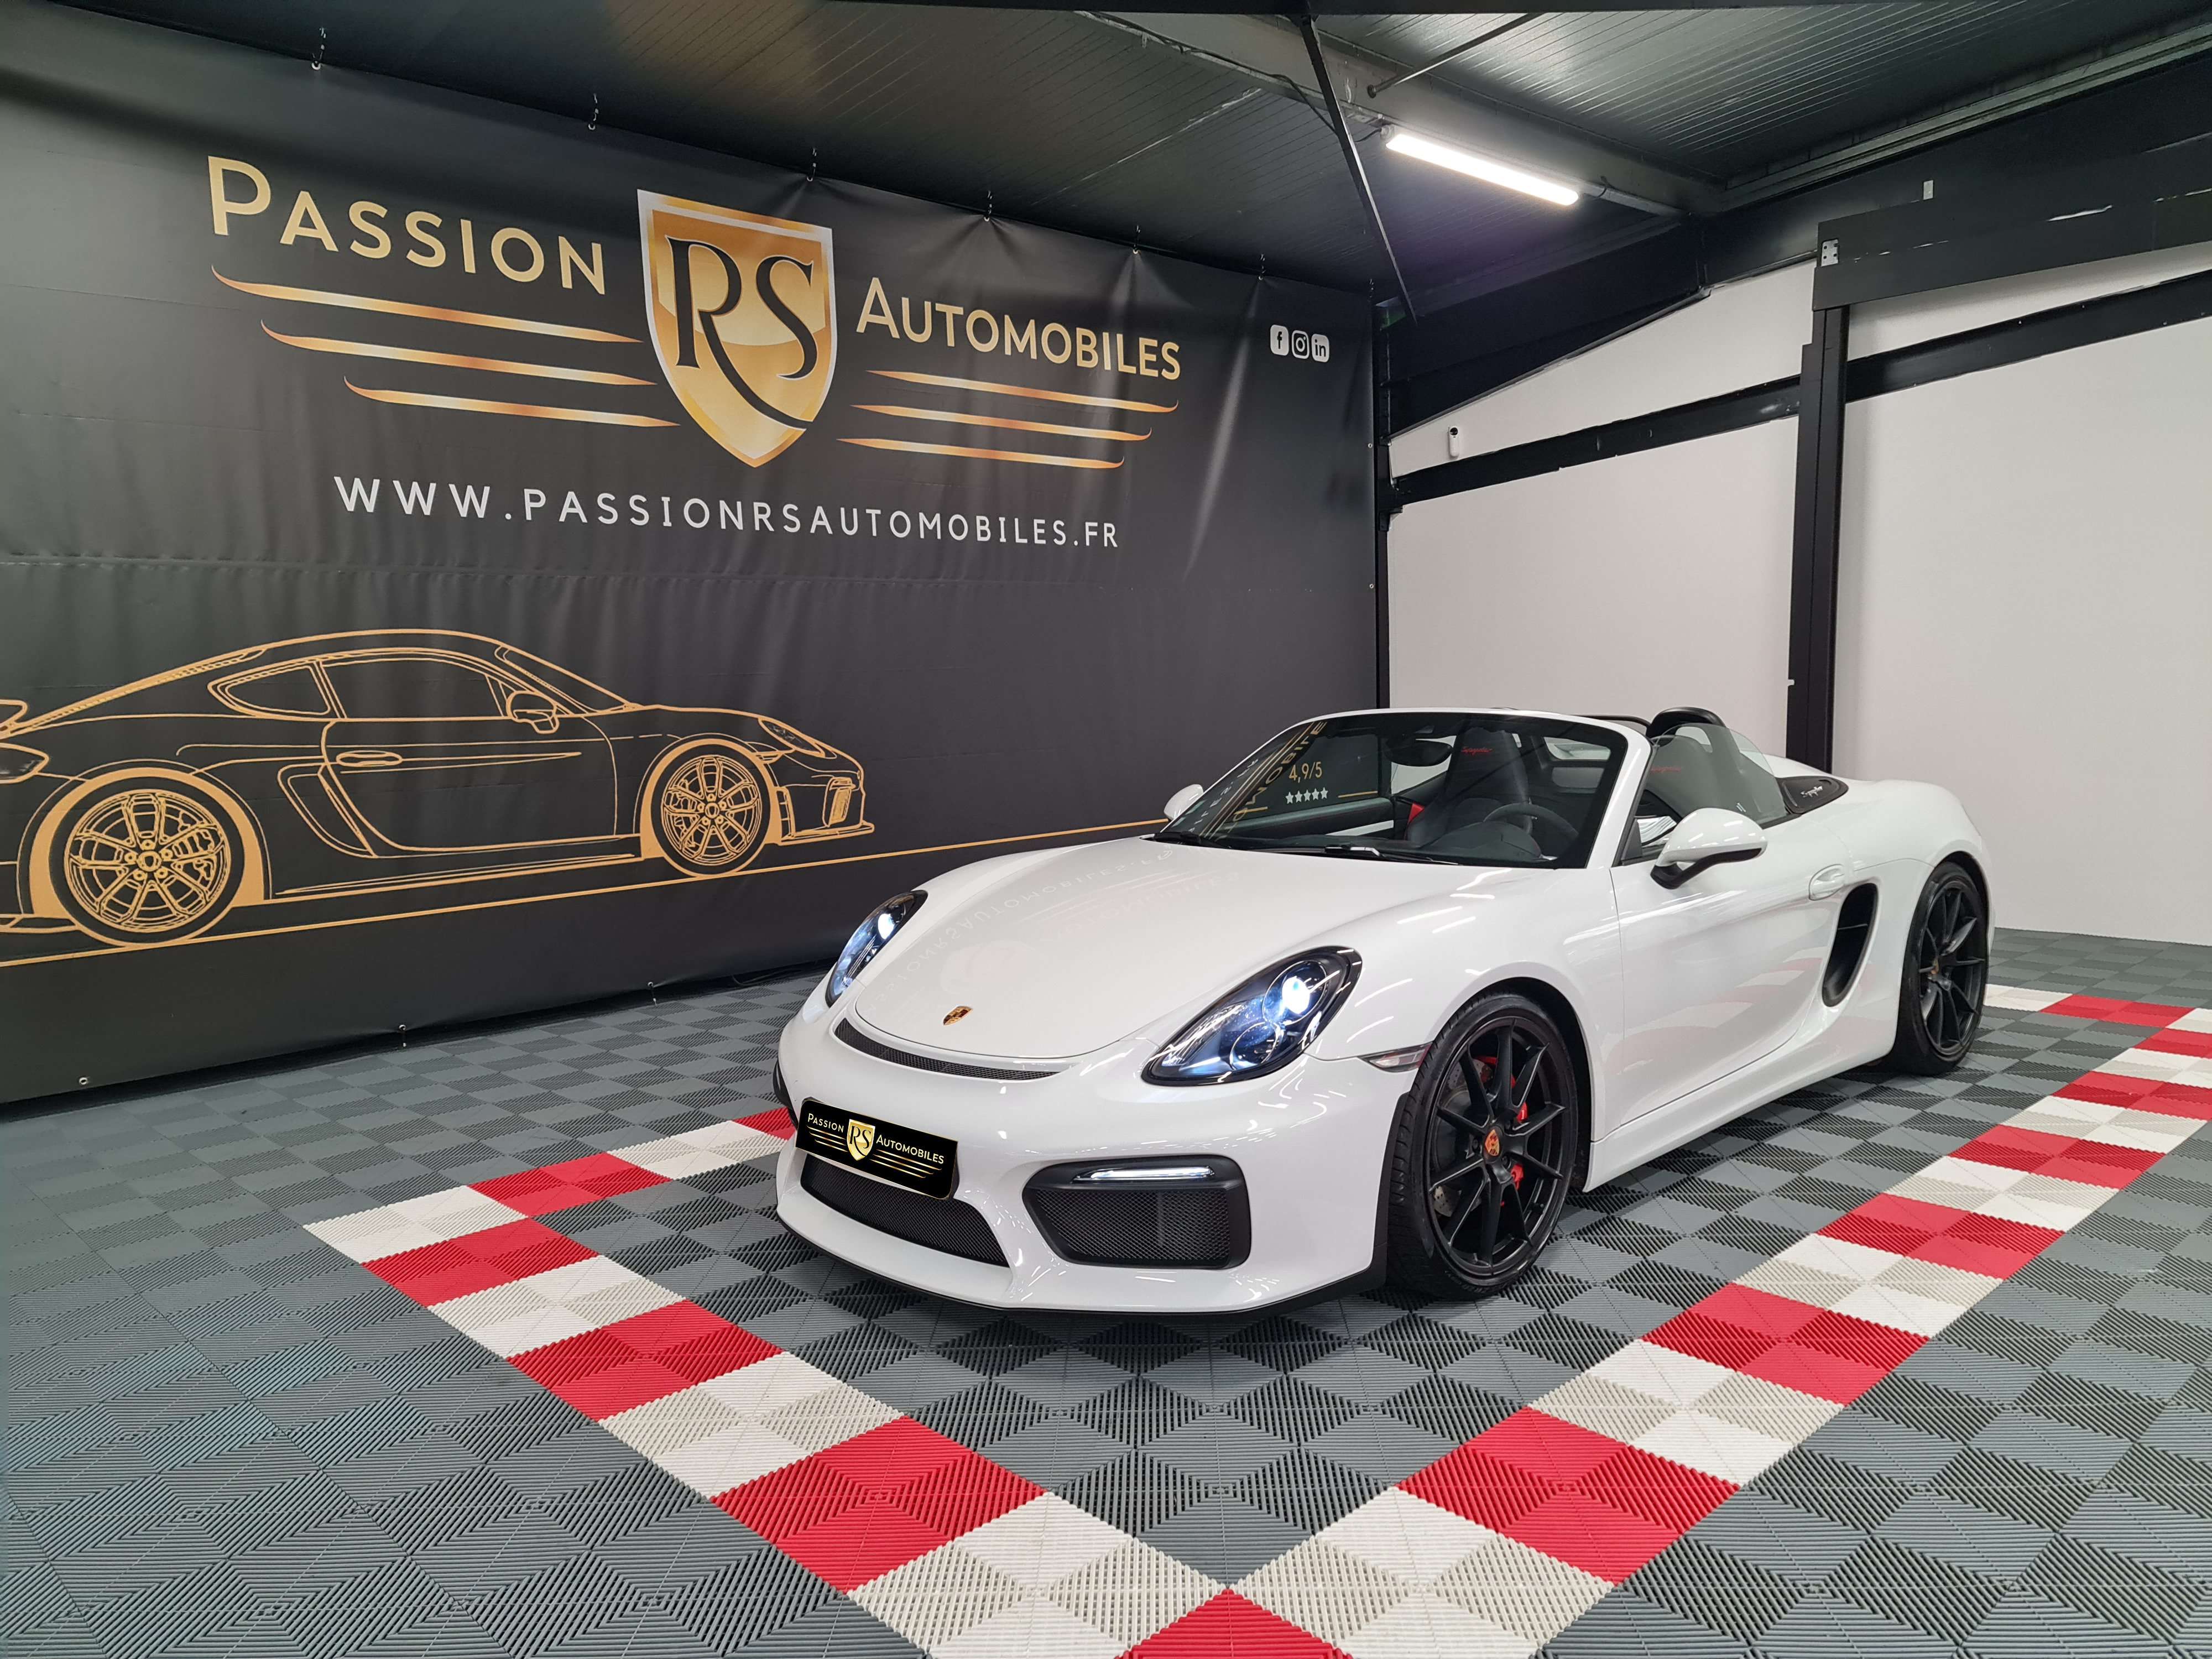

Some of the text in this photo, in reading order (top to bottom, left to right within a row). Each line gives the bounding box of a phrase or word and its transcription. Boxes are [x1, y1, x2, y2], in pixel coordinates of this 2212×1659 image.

[207, 155, 1181, 430] PASSION RS AUTOMOBILES
[333, 476, 1118, 547] WWW.PASSIONRSAUTOMOBILES.FR
[1288, 761, 1323, 782] 4,9/5
[807, 1113, 945, 1164] PASSION RS AUTOMOBILES
